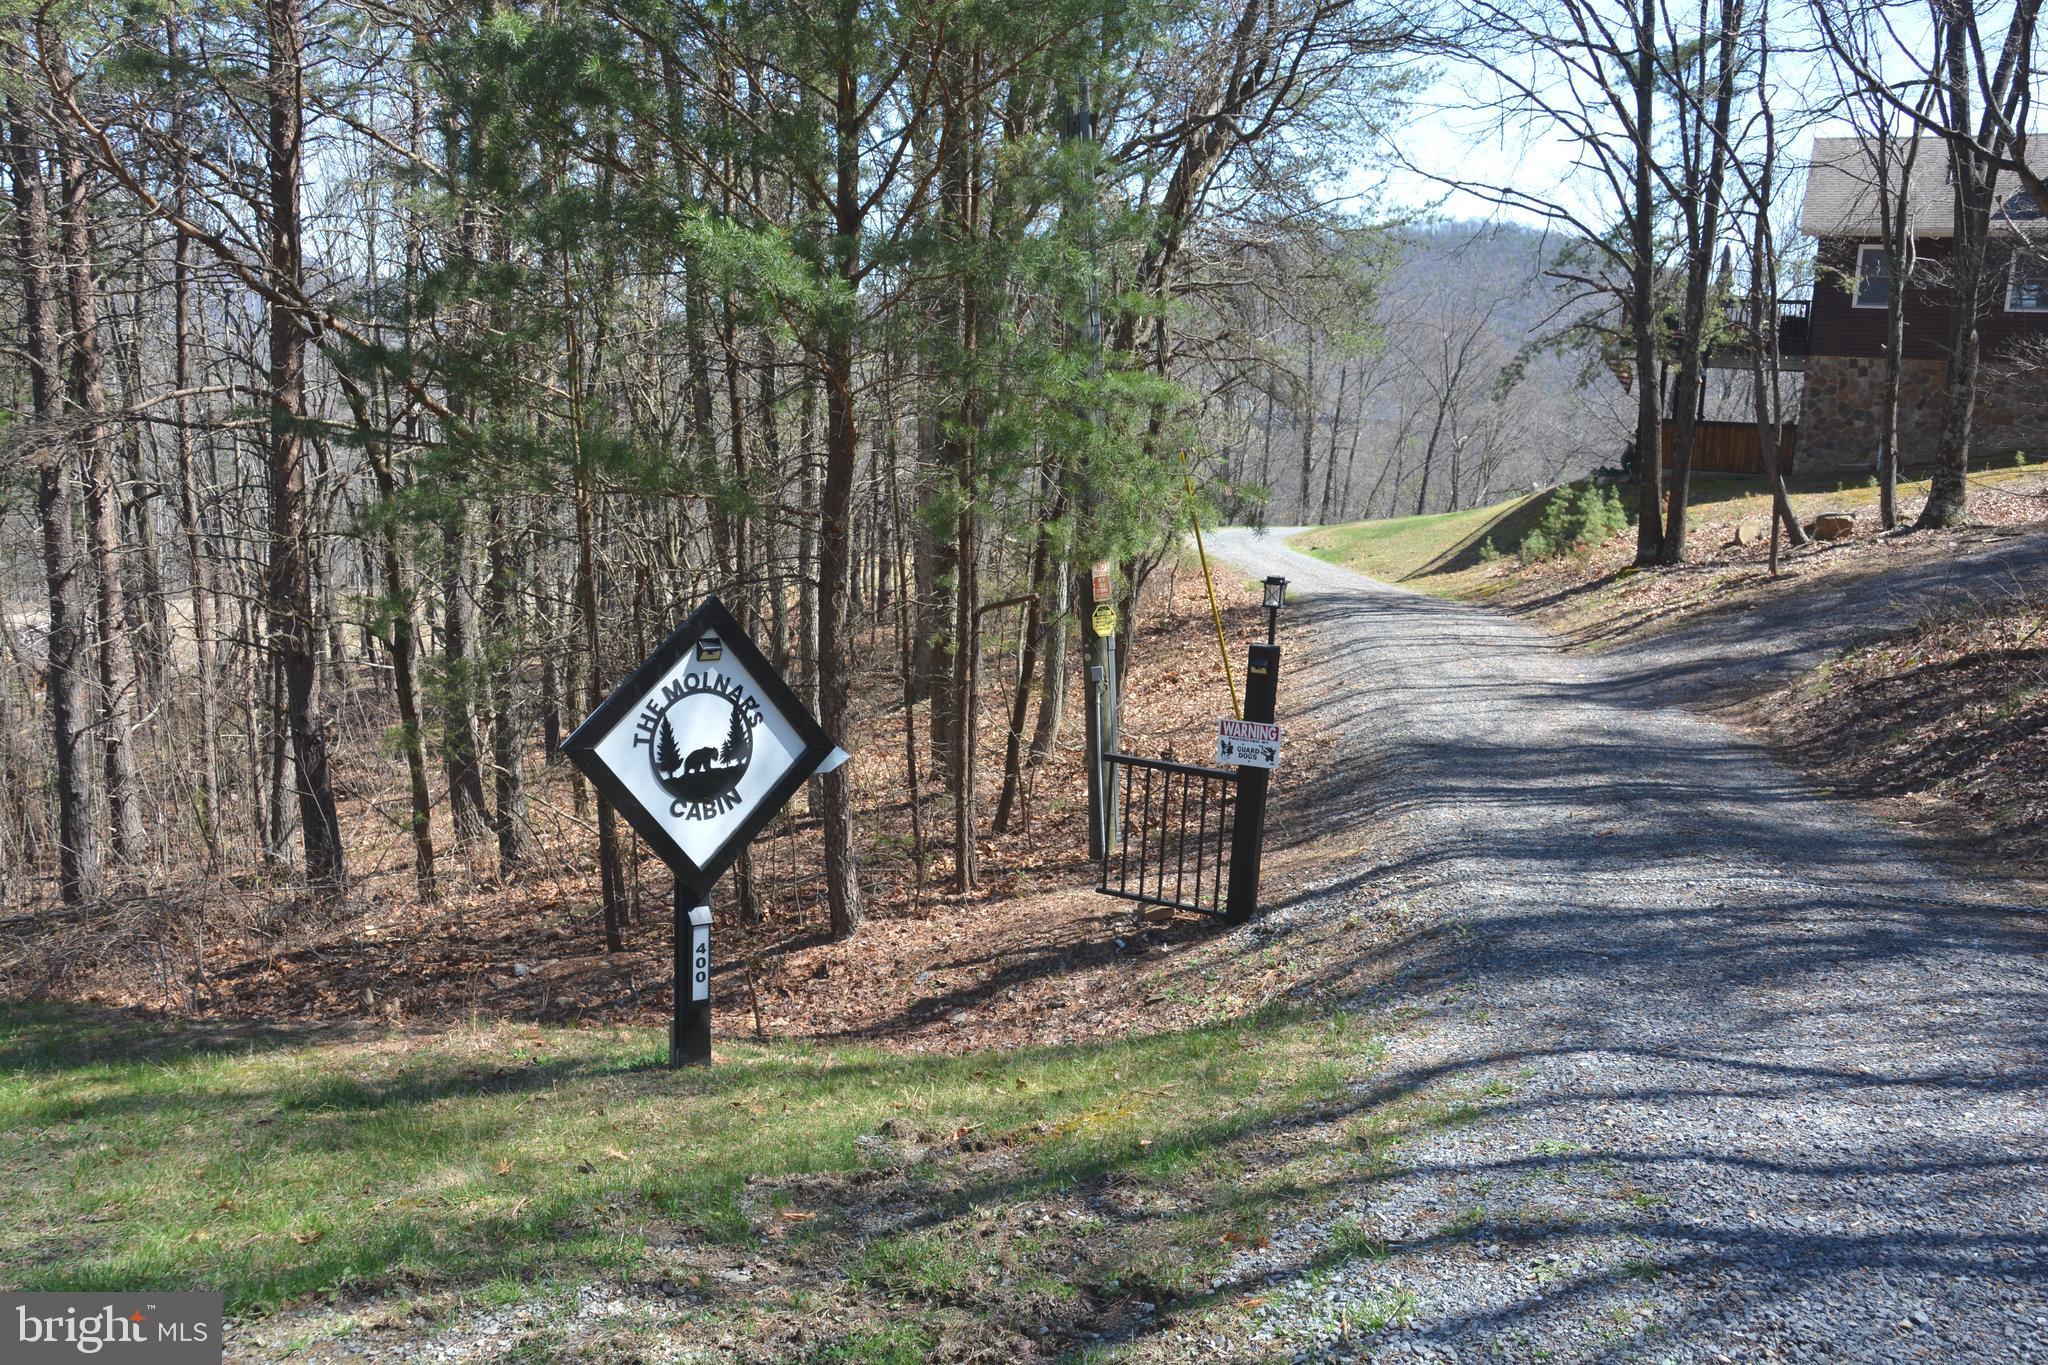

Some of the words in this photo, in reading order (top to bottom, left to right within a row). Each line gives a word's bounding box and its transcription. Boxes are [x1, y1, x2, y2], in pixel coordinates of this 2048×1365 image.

[633, 698, 664, 748] THE
[1223, 721, 1277, 740] WARNING
[1237, 746, 1259, 754] GUARD
[669, 787, 742, 821] CABIN
[695, 942, 707, 983] 400
